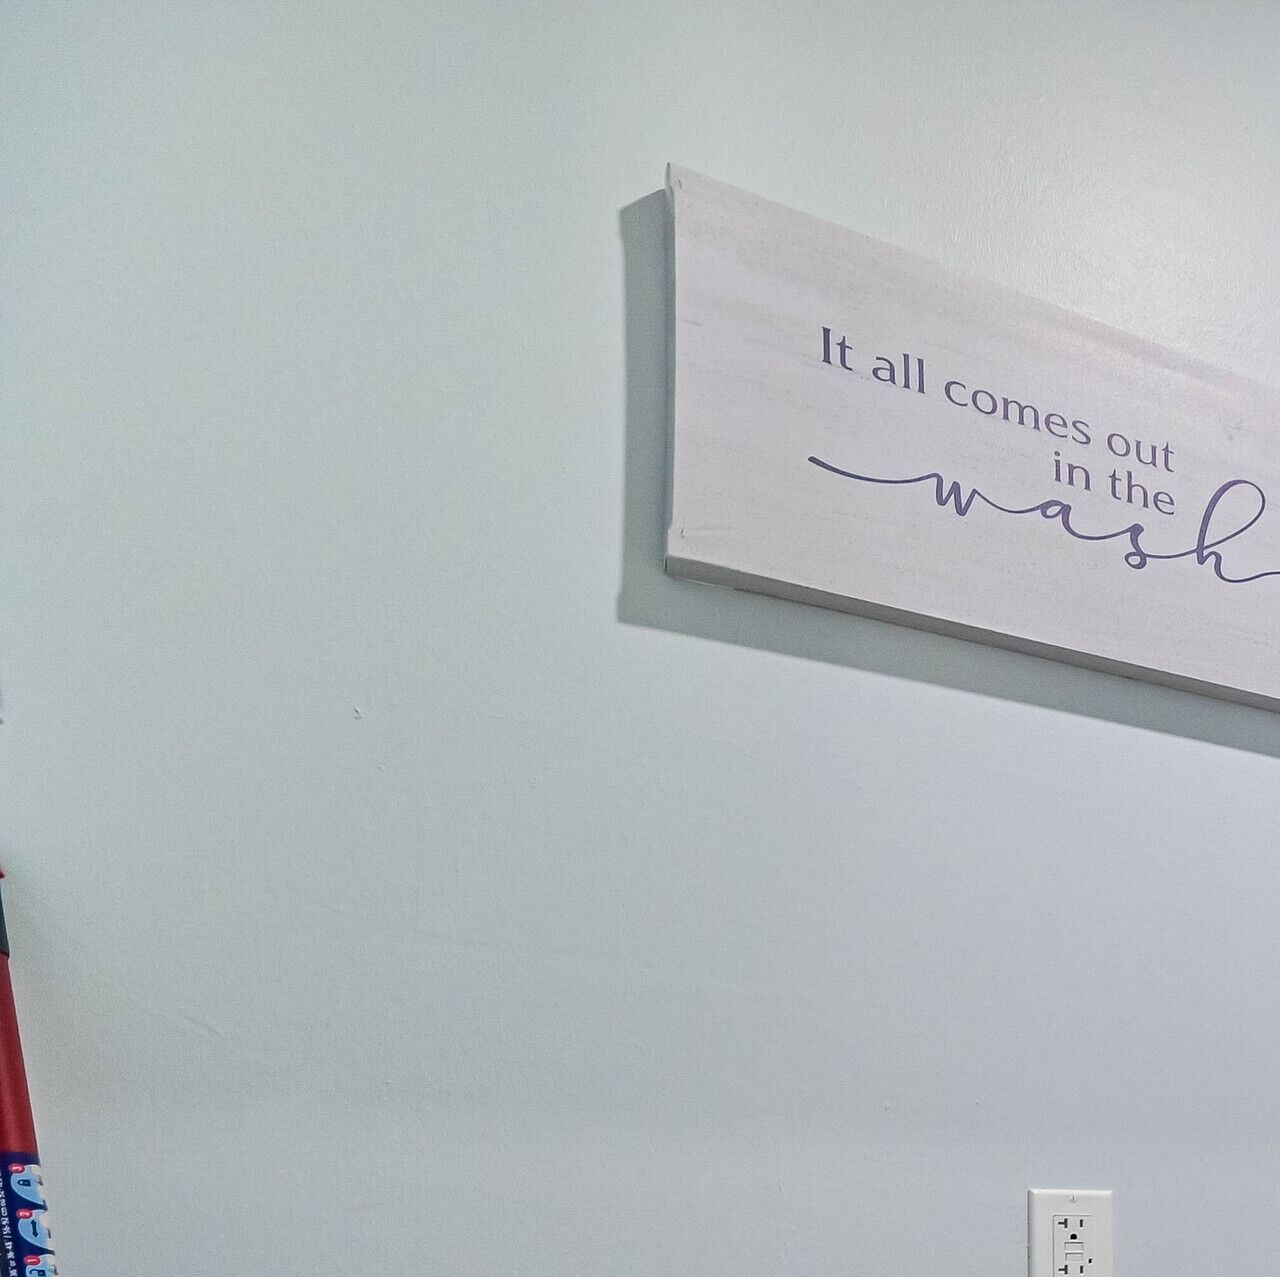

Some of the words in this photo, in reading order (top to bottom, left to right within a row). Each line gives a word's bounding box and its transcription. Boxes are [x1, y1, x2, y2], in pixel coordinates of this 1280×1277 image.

[820, 327, 853, 371] It
[872, 353, 926, 394] all
[944, 378, 1091, 446] comes
[1107, 430, 1174, 473] out
[1053, 450, 1091, 491] in
[1109, 469, 1175, 516] the
